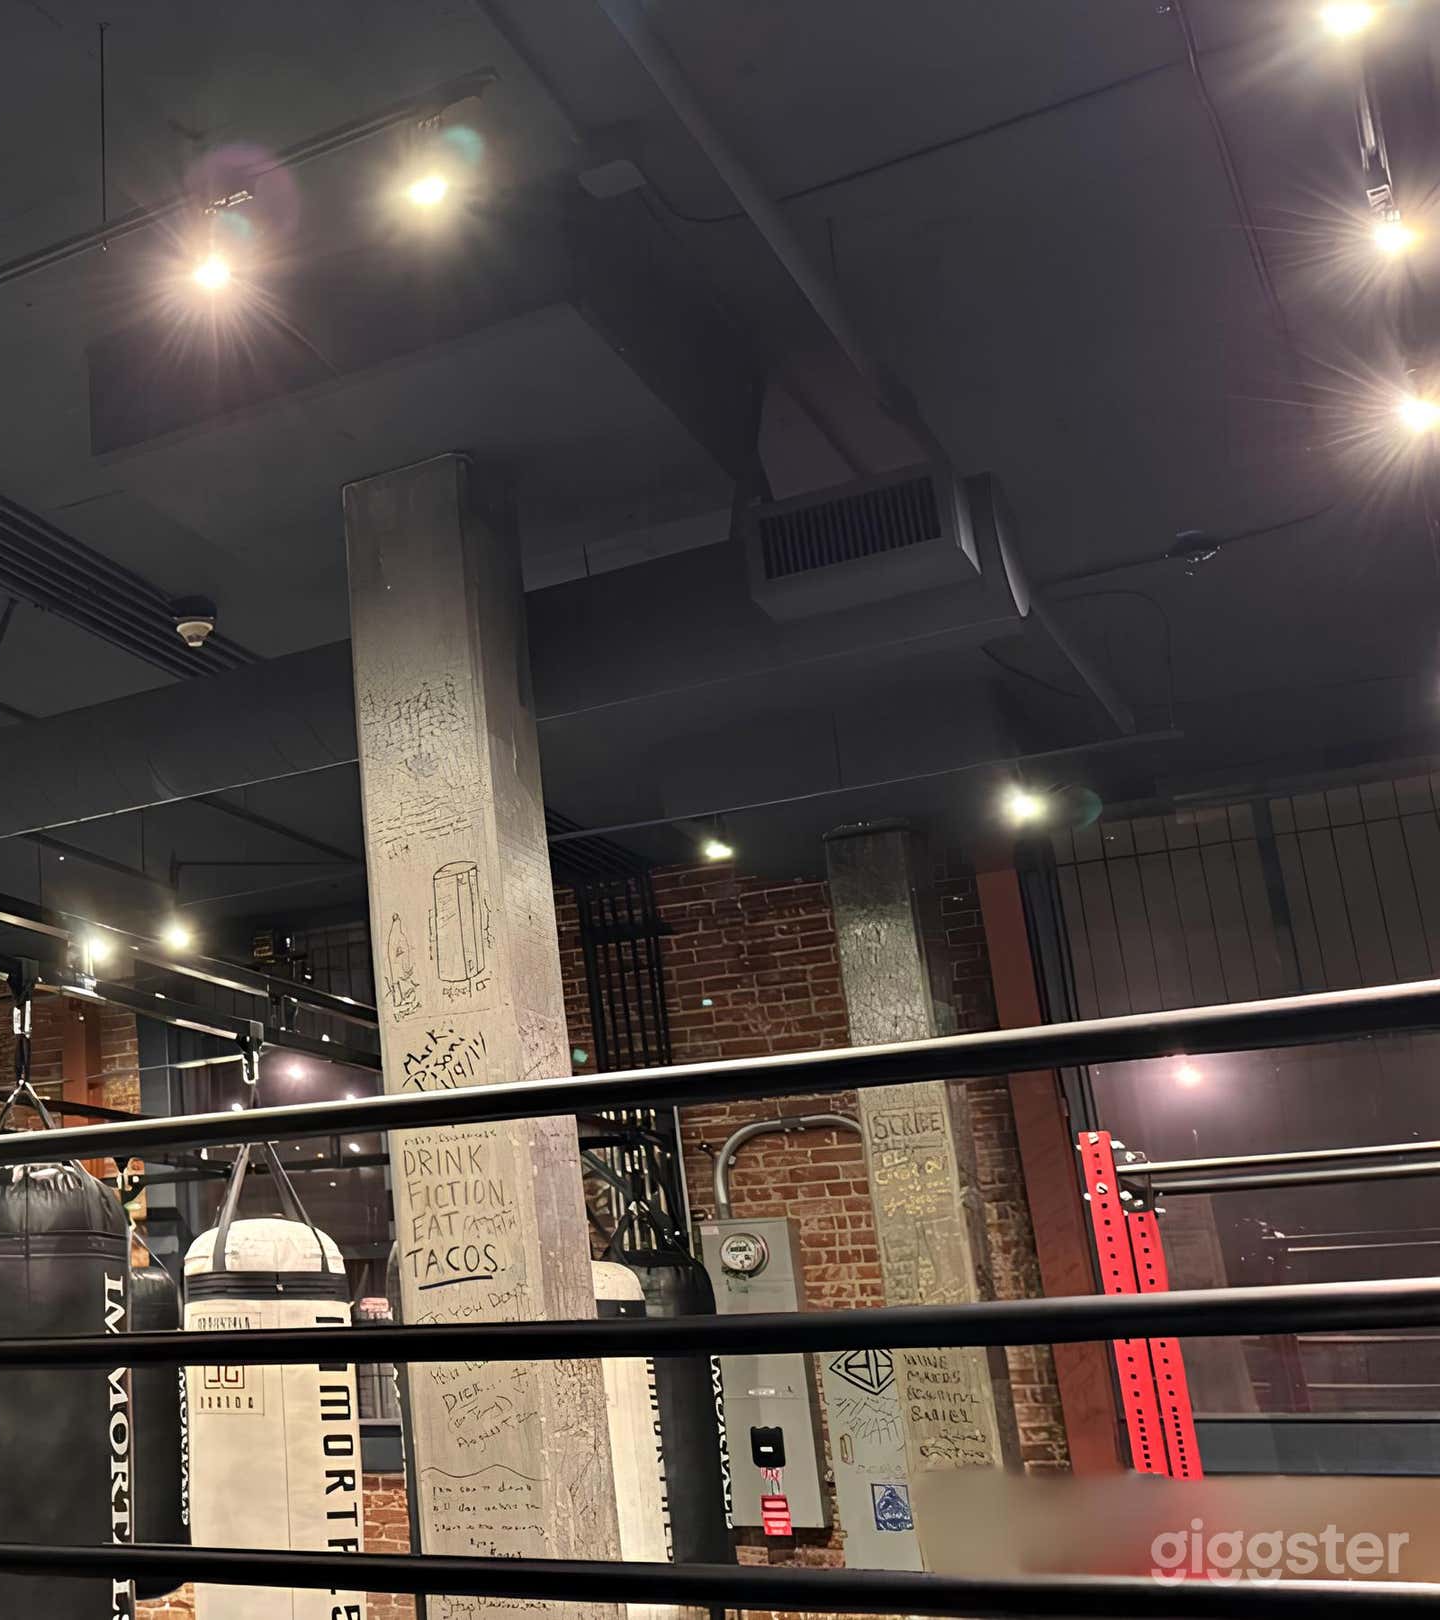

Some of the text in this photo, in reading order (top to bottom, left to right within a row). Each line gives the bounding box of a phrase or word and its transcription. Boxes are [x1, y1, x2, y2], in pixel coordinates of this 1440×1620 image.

[403, 1144, 482, 1177] DRINK
[412, 1210, 460, 1244] EAT
[404, 1243, 506, 1279] TACOS.
